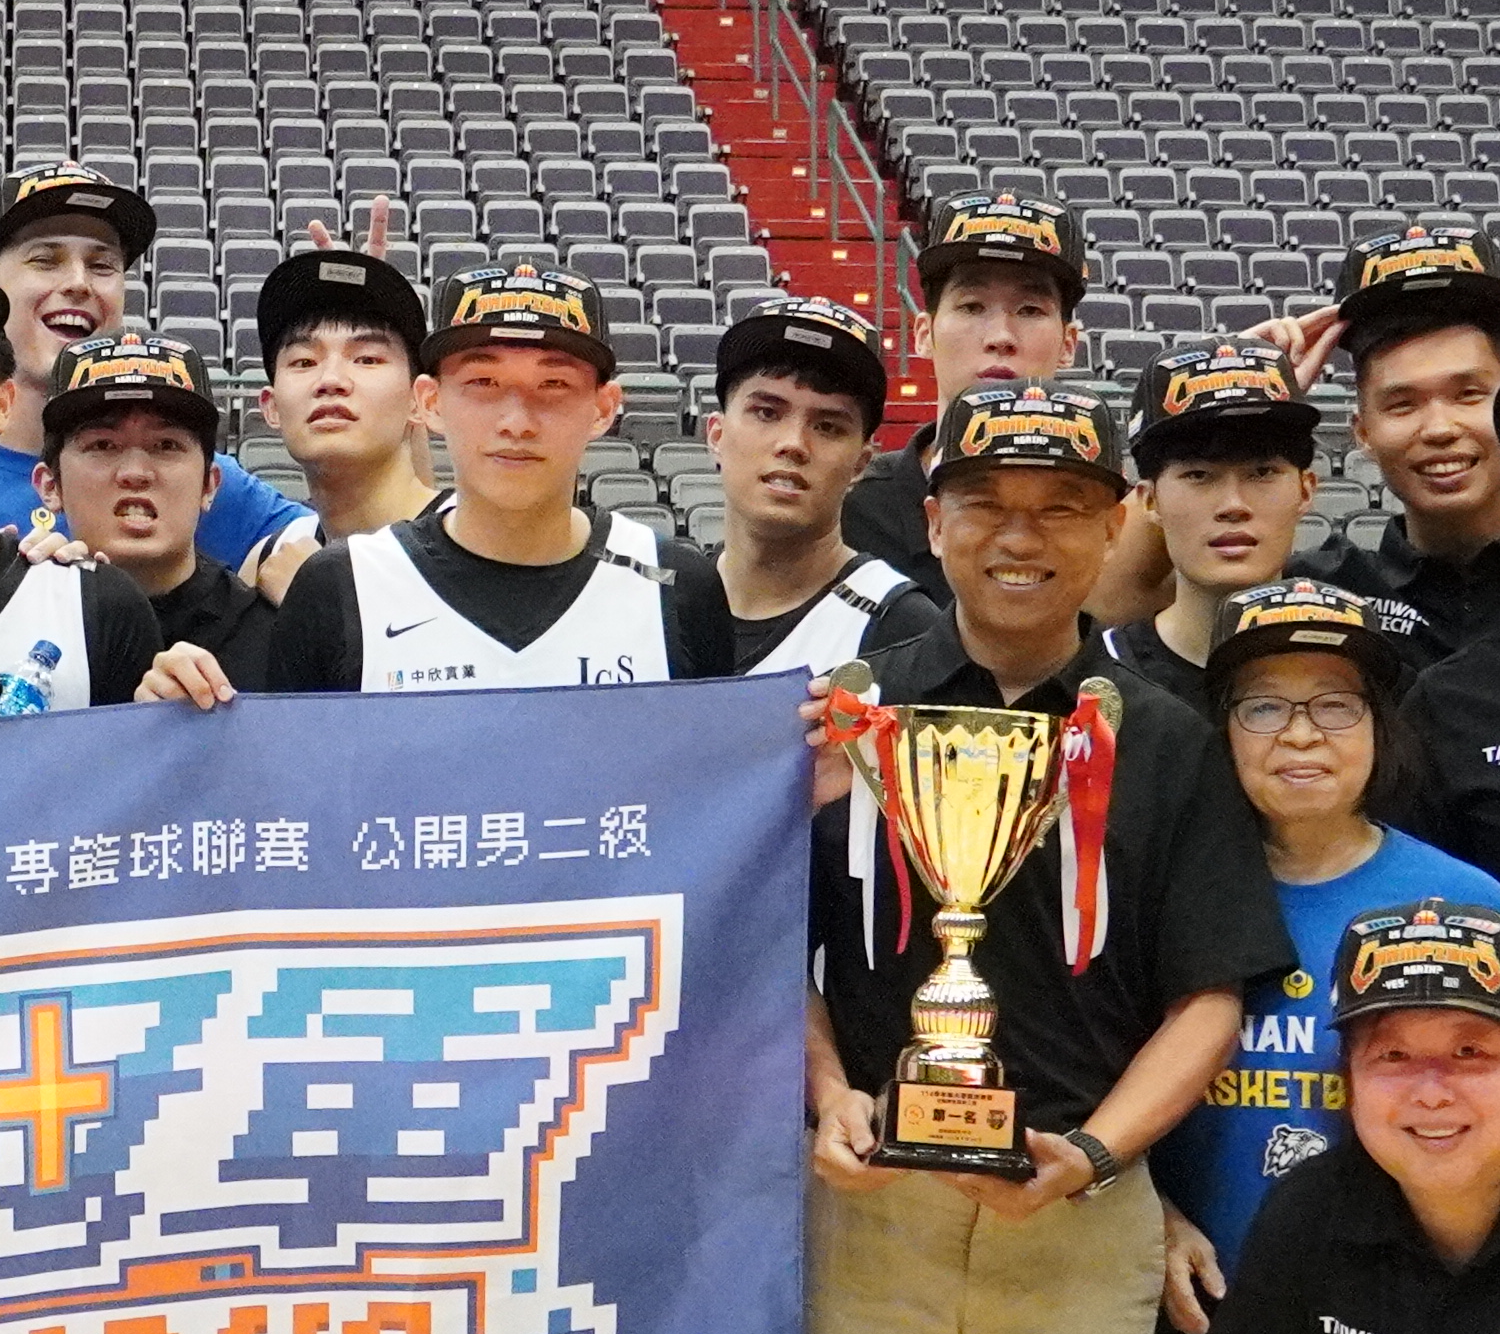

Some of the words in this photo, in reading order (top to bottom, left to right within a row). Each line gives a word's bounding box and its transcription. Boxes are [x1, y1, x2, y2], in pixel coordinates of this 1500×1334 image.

[353, 803, 653, 871] 公開男二級
[1204, 1069, 1347, 1110] SKETB
[932, 1109, 977, 1124] 第一名
